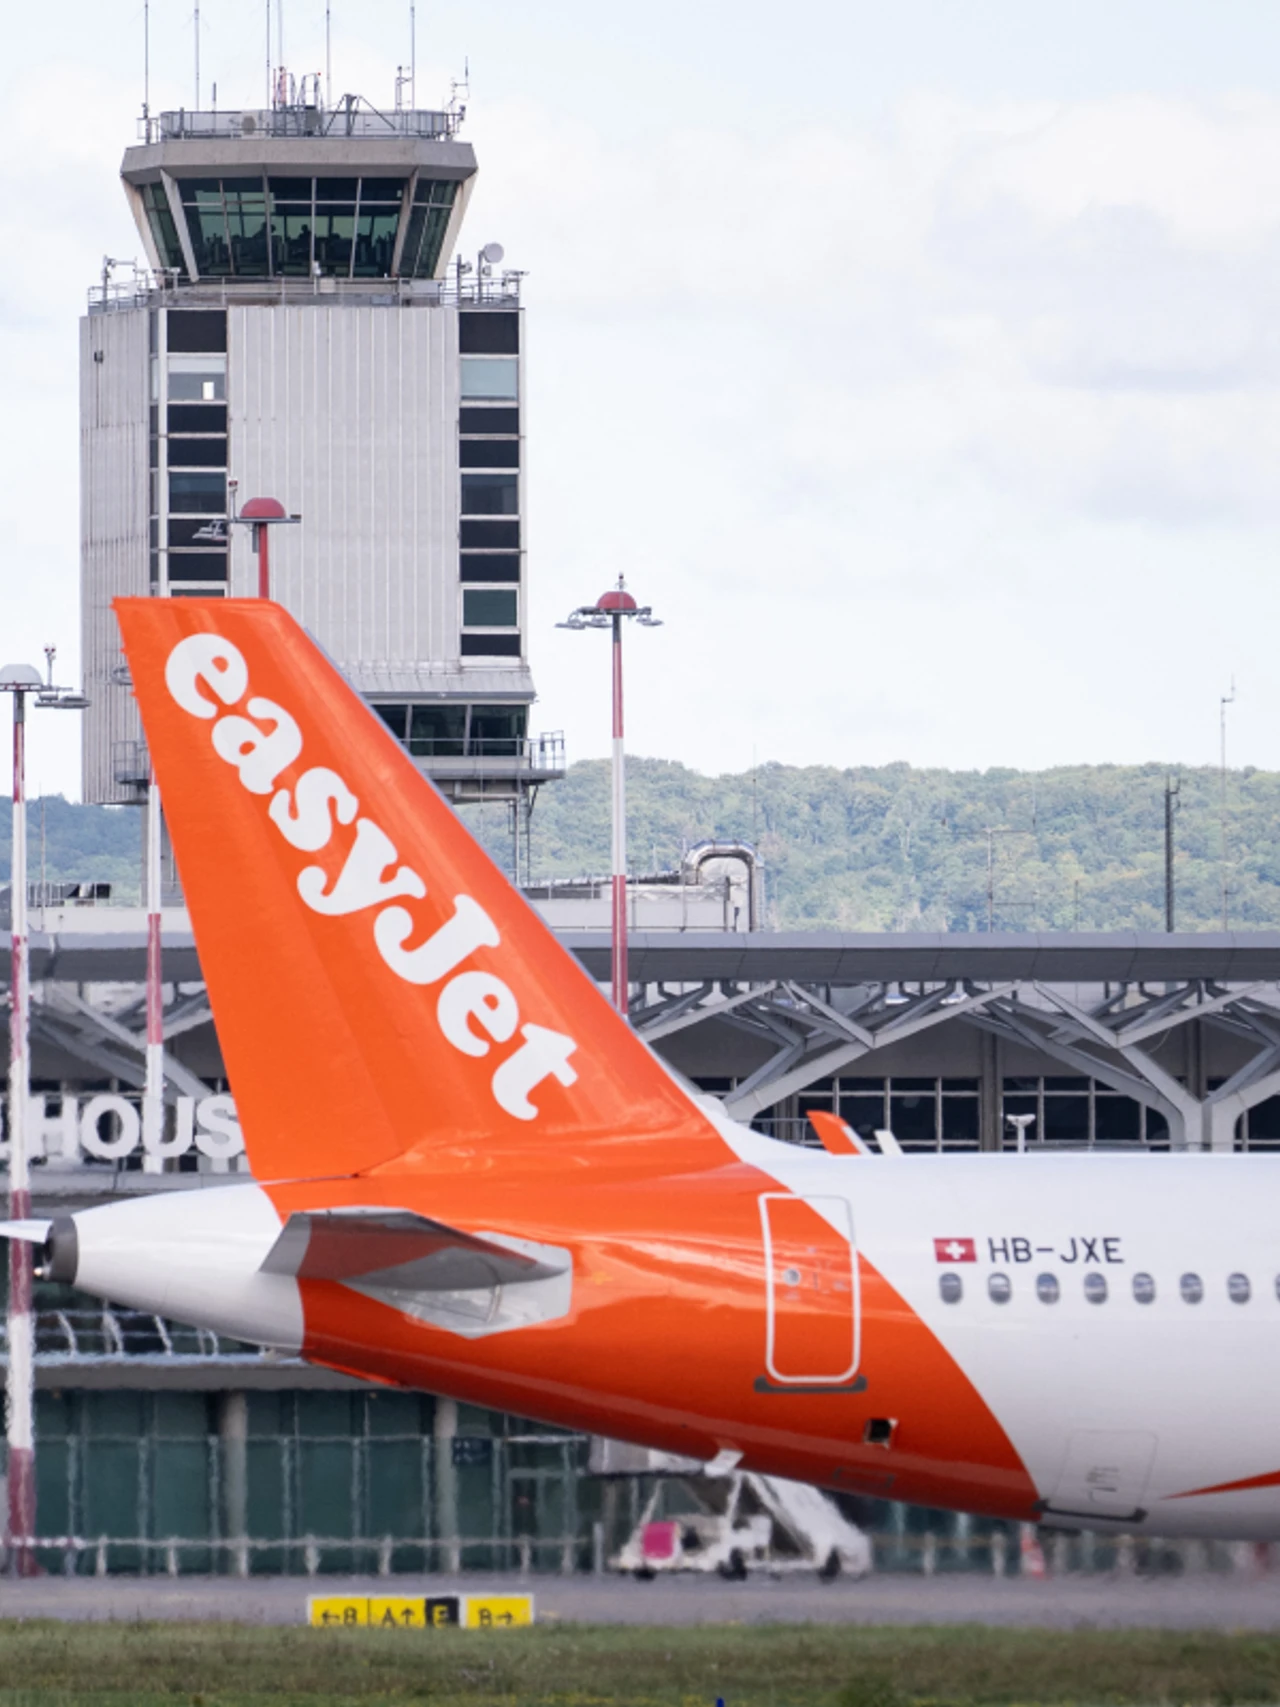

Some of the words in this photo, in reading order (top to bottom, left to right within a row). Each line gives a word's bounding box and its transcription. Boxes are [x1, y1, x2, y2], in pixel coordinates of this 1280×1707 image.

[164, 632, 579, 1121] easyJet
[987, 1236, 1125, 1263] HB-JXE
[381, 1607, 396, 1627] A
